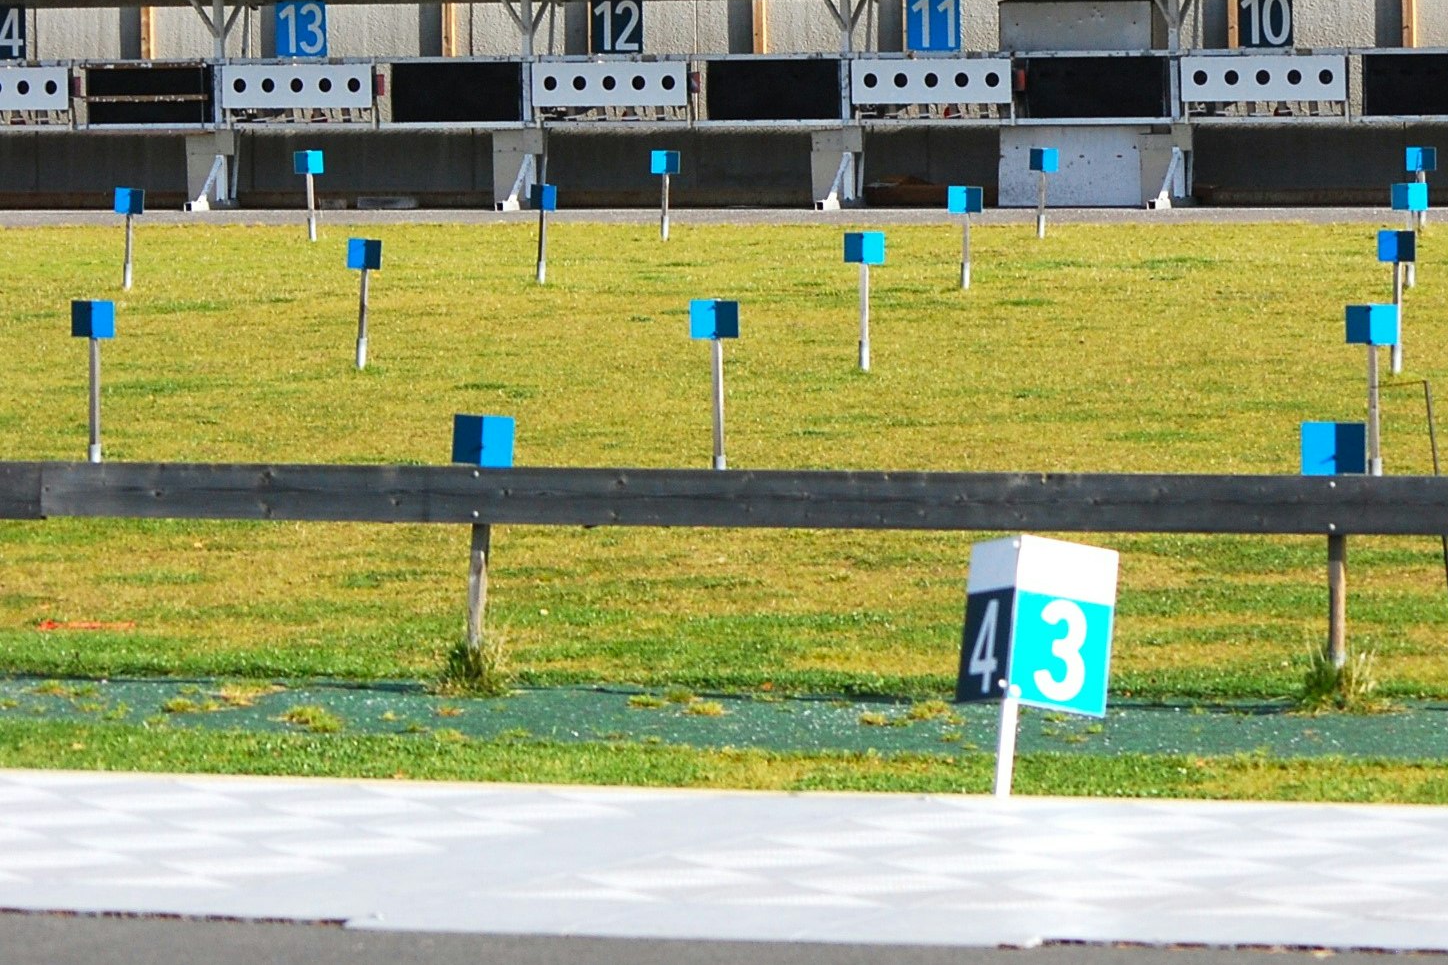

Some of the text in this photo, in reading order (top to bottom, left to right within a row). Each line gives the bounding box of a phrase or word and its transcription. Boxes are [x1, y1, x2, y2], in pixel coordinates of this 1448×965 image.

[278, 2, 324, 54] 13
[594, 0, 640, 51] 12
[968, 598, 999, 694] 4
[1033, 599, 1088, 702] 3
